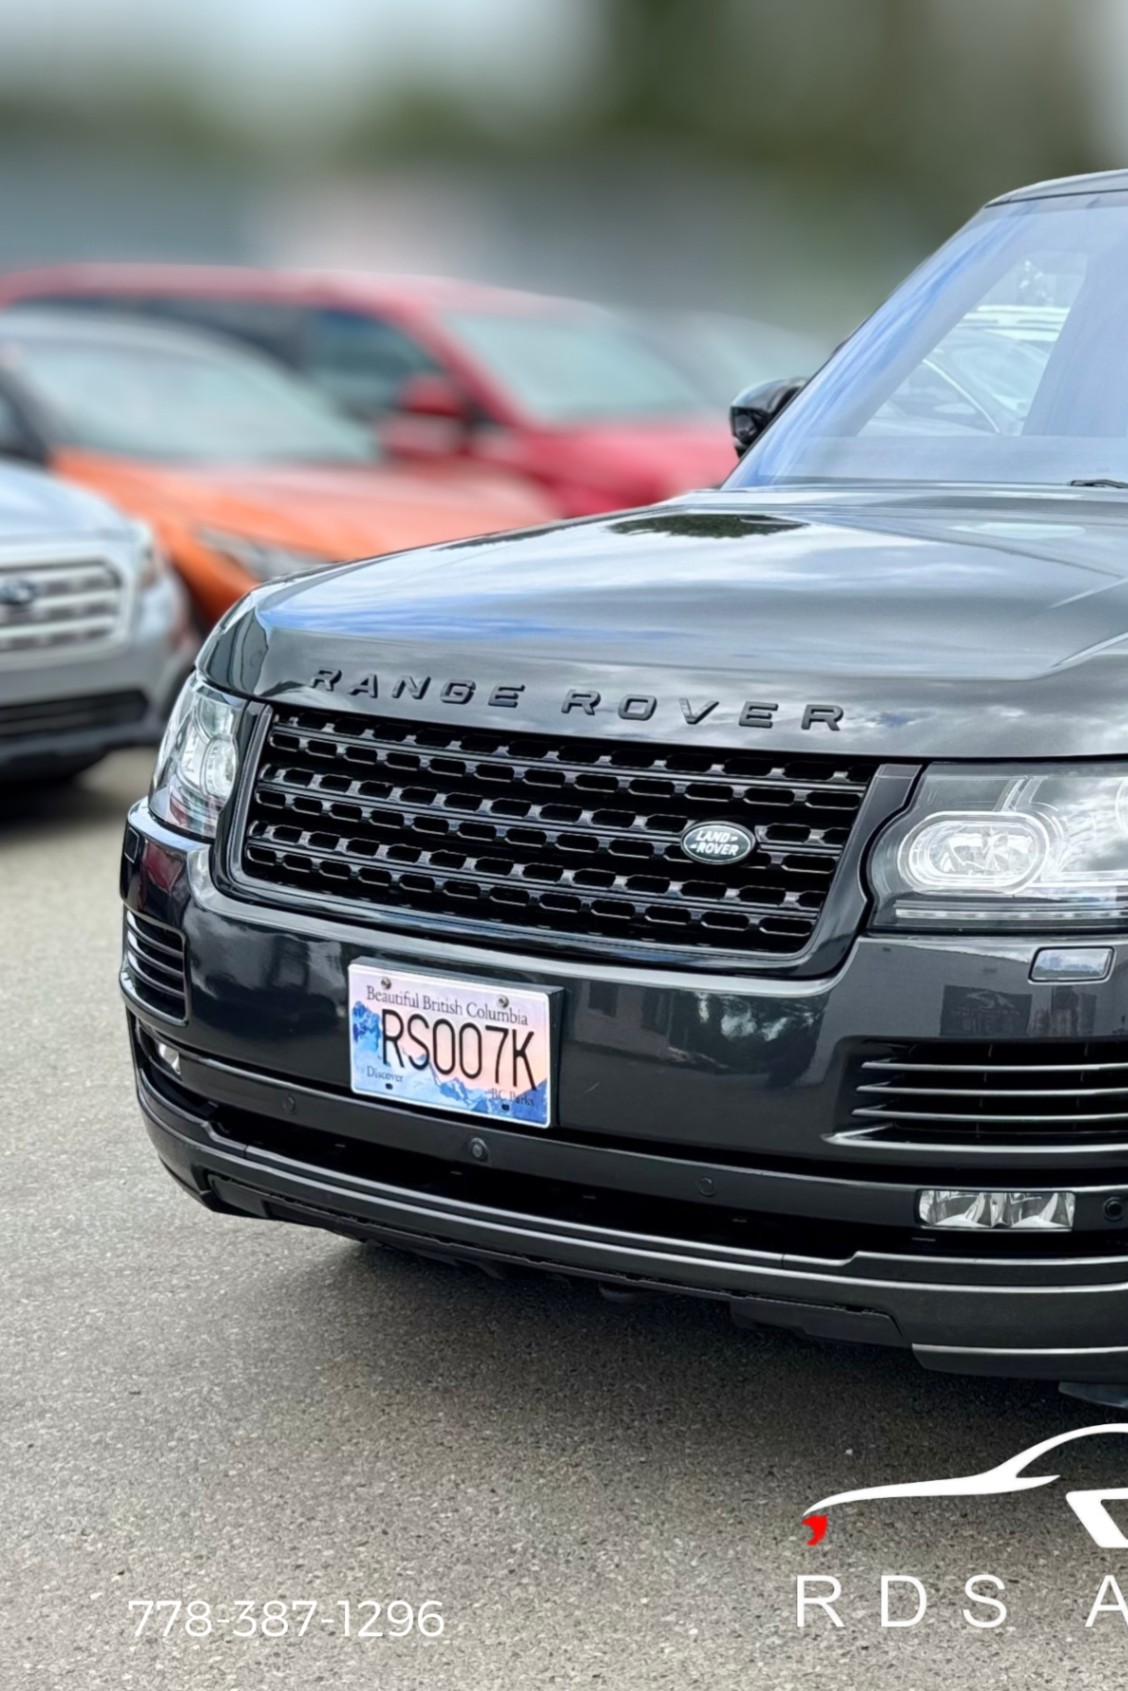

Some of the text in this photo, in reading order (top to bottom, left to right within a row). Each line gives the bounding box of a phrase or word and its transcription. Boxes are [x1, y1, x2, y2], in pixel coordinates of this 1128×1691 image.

[309, 667, 845, 732] RANGE ROVER
[696, 830, 731, 843] LAND
[696, 842, 739, 856] ROVER
[367, 986, 528, 1026] Beautiful British Columbia
[366, 1065, 404, 1083] Discover
